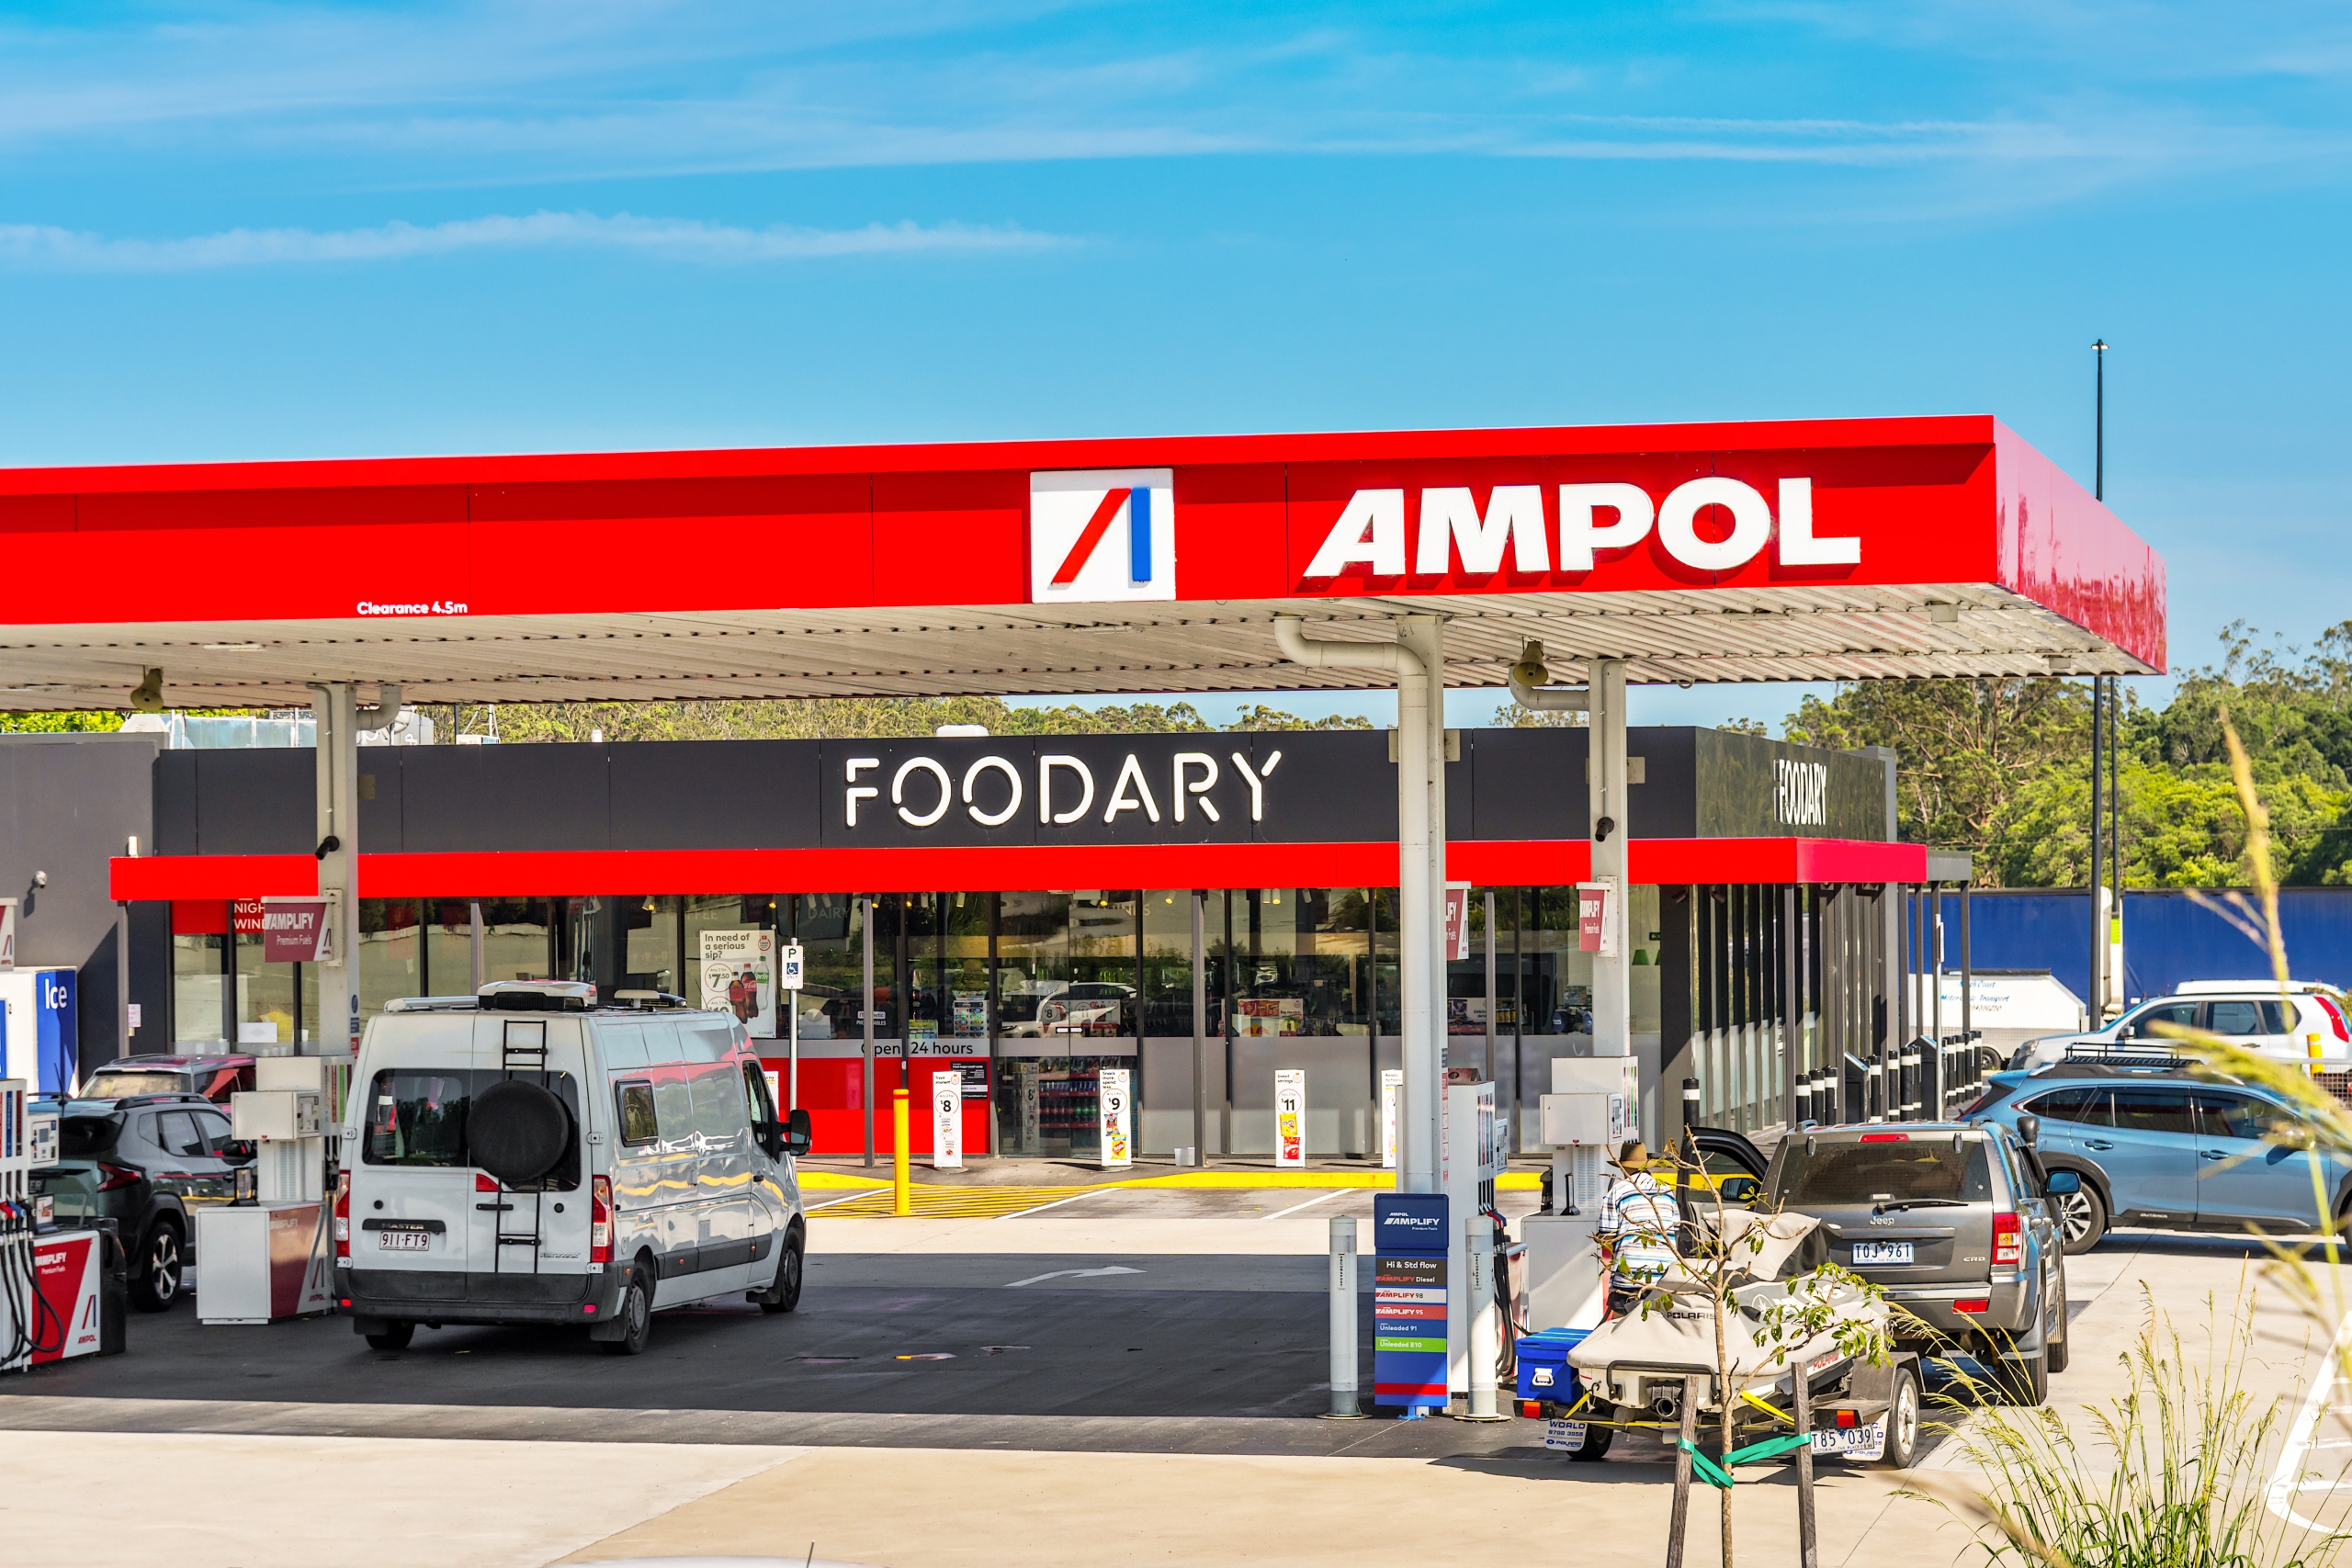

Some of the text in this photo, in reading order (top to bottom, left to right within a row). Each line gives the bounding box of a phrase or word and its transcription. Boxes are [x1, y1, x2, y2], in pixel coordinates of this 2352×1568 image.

[1303, 477, 1861, 578] AMPOL
[356, 601, 468, 615] Clearance 4.5m
[845, 750, 1282, 827] FOODARY
[1778, 759, 1827, 826] FOODARY
[233, 903, 266, 914] NIGH
[808, 907, 852, 919] DAIRY
[1445, 901, 1457, 921] LIFY
[269, 913, 315, 931] AMPLIFY
[277, 934, 312, 946] Premium Fuels
[705, 933, 714, 942] In
[716, 933, 738, 942] need
[713, 942, 745, 950] serious
[705, 951, 723, 961] sip?
[788, 948, 797, 958] P
[708, 974, 729, 988] $7.50
[44, 978, 68, 1010] Ice
[1979, 995, 2010, 1003] Transport
[861, 1042, 974, 1057] pen 24 hours
[940, 1100, 952, 1112] $8
[1108, 1098, 1120, 1111] $9
[1281, 1099, 1295, 1111] $11
[1391, 1218, 1441, 1226] AMPLIFY
[1869, 1215, 1895, 1226] Jeep
[1856, 1244, 1910, 1258] TOJ 961
[36, 1252, 67, 1267] AMPLIFY
[1419, 1261, 1437, 1269] flow
[1667, 1312, 1715, 1320] POLARIS
[78, 1335, 96, 1345] AMPOL
[1549, 1420, 1586, 1429] WORLD
[1812, 1428, 1871, 1449] T85 039
